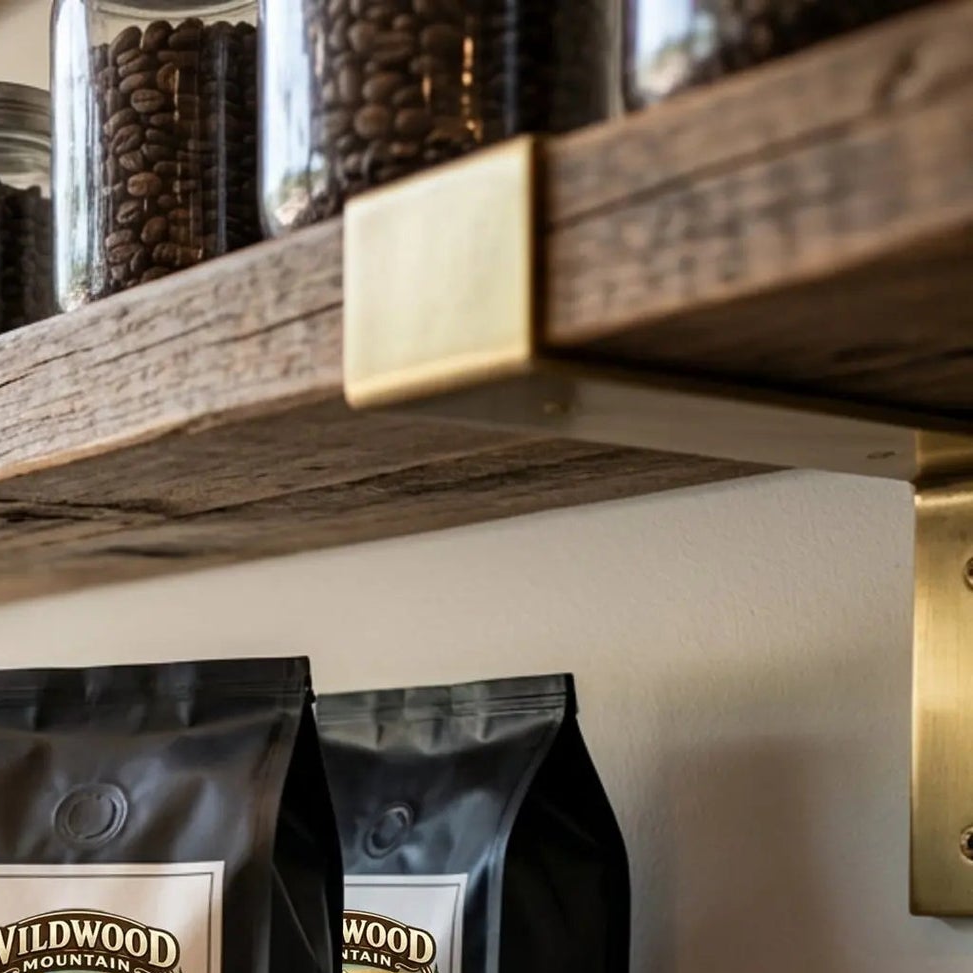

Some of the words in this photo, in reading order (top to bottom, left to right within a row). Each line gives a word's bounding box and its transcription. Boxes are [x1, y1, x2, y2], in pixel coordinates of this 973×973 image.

[342, 919, 433, 964] WOOD
[23, 954, 130, 973] MOUNTAIN
[342, 949, 391, 967] NTAIN
